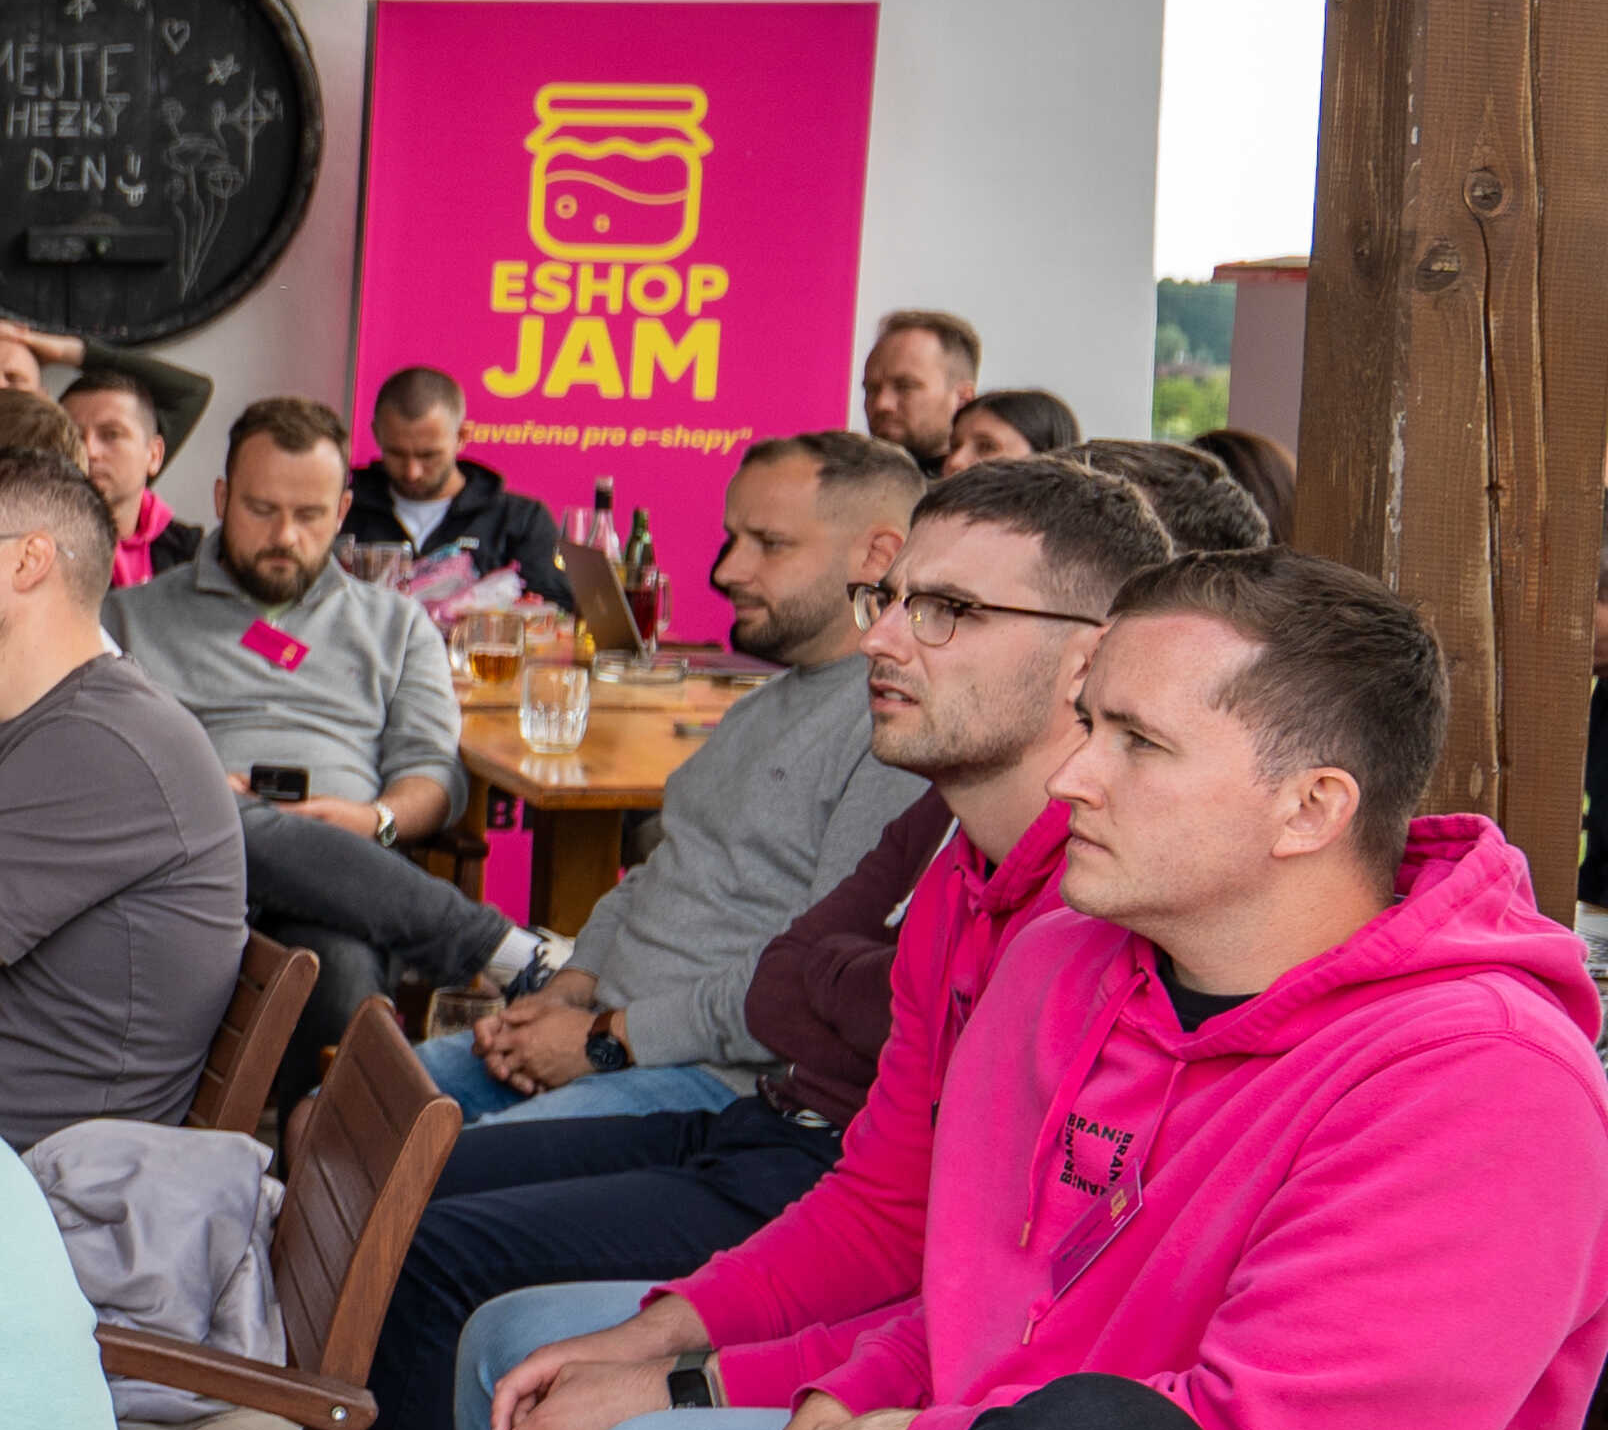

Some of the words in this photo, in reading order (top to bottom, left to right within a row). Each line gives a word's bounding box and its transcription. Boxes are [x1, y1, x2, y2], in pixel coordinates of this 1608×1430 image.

[28, 147, 107, 192] DEN
[490, 260, 730, 316] ESHOP
[482, 314, 721, 401] JAM
[580, 426, 626, 452] pro
